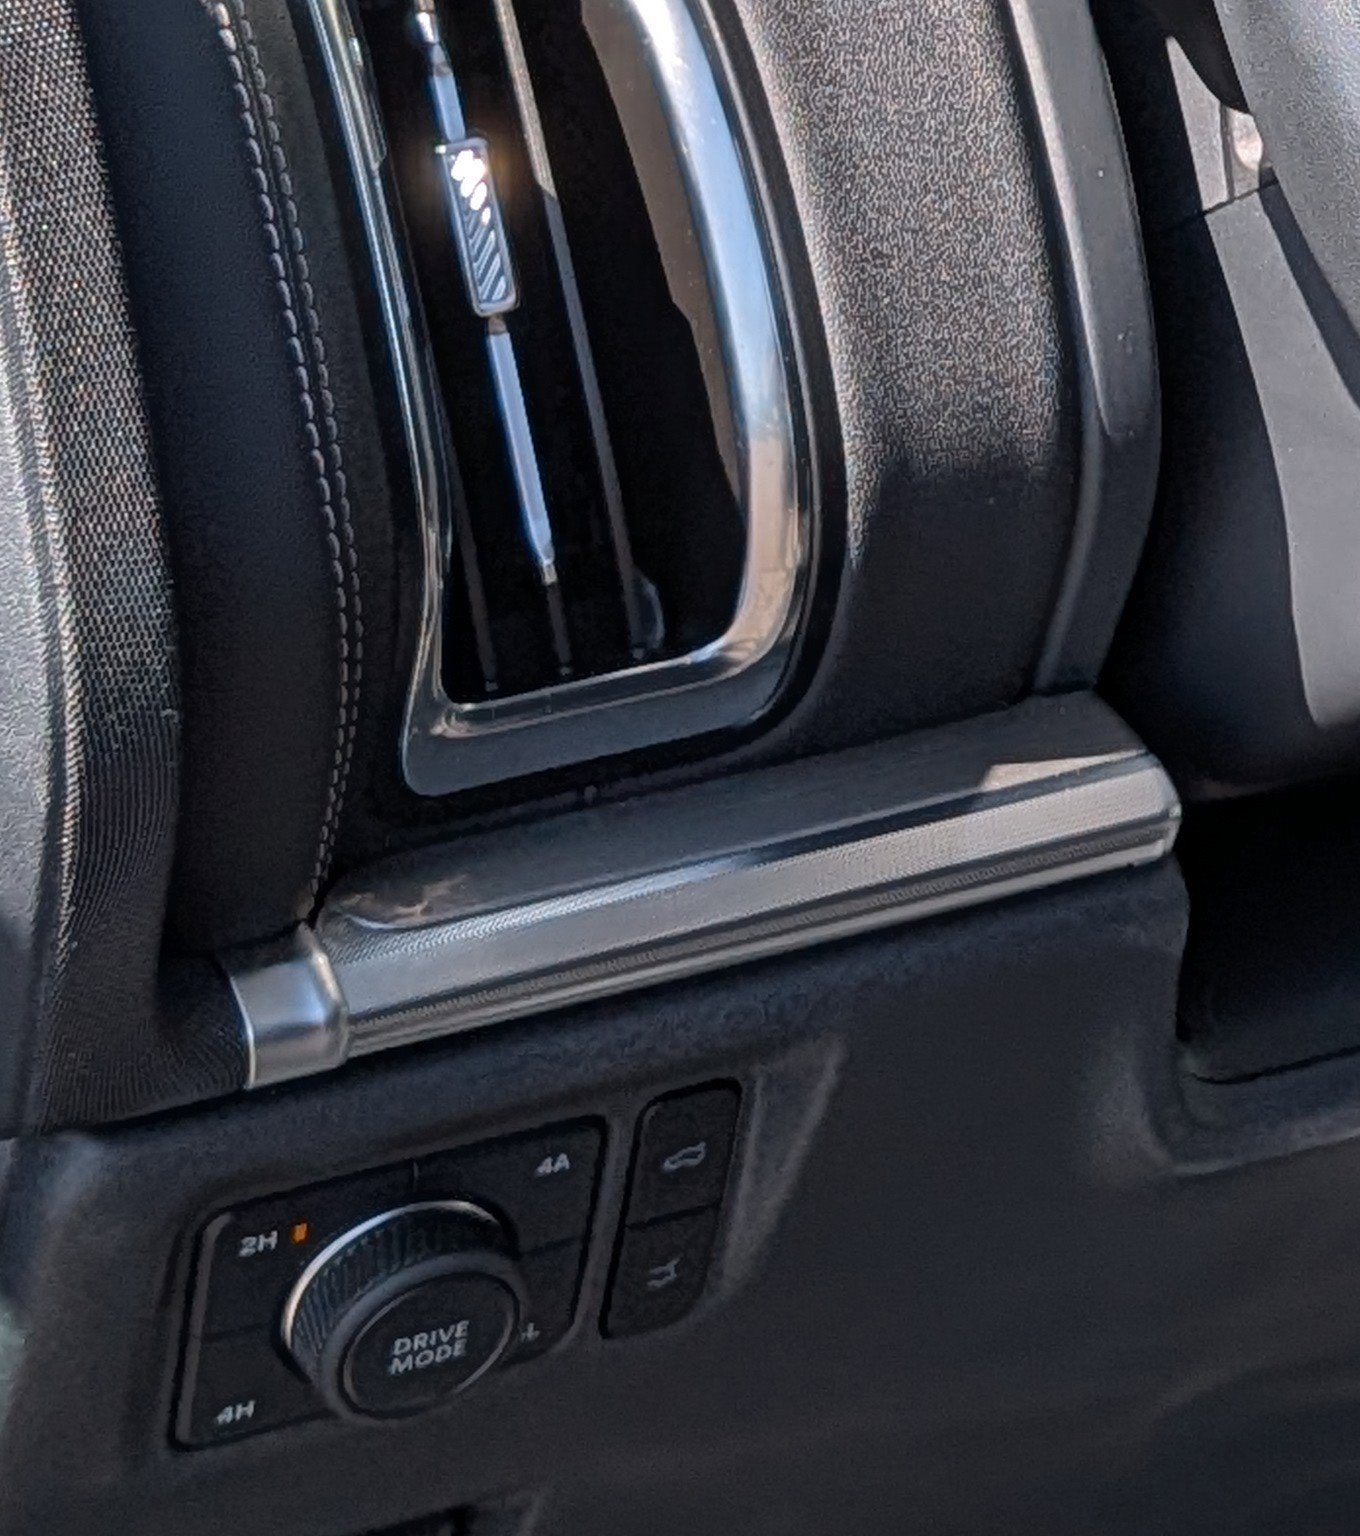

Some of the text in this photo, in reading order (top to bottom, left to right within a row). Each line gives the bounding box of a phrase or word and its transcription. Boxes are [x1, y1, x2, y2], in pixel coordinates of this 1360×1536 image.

[535, 1152, 572, 1179] 4A
[238, 1229, 280, 1258] 2H
[392, 1319, 471, 1359] DRIVE
[387, 1337, 468, 1377] MODE
[214, 1399, 257, 1426] 4H
